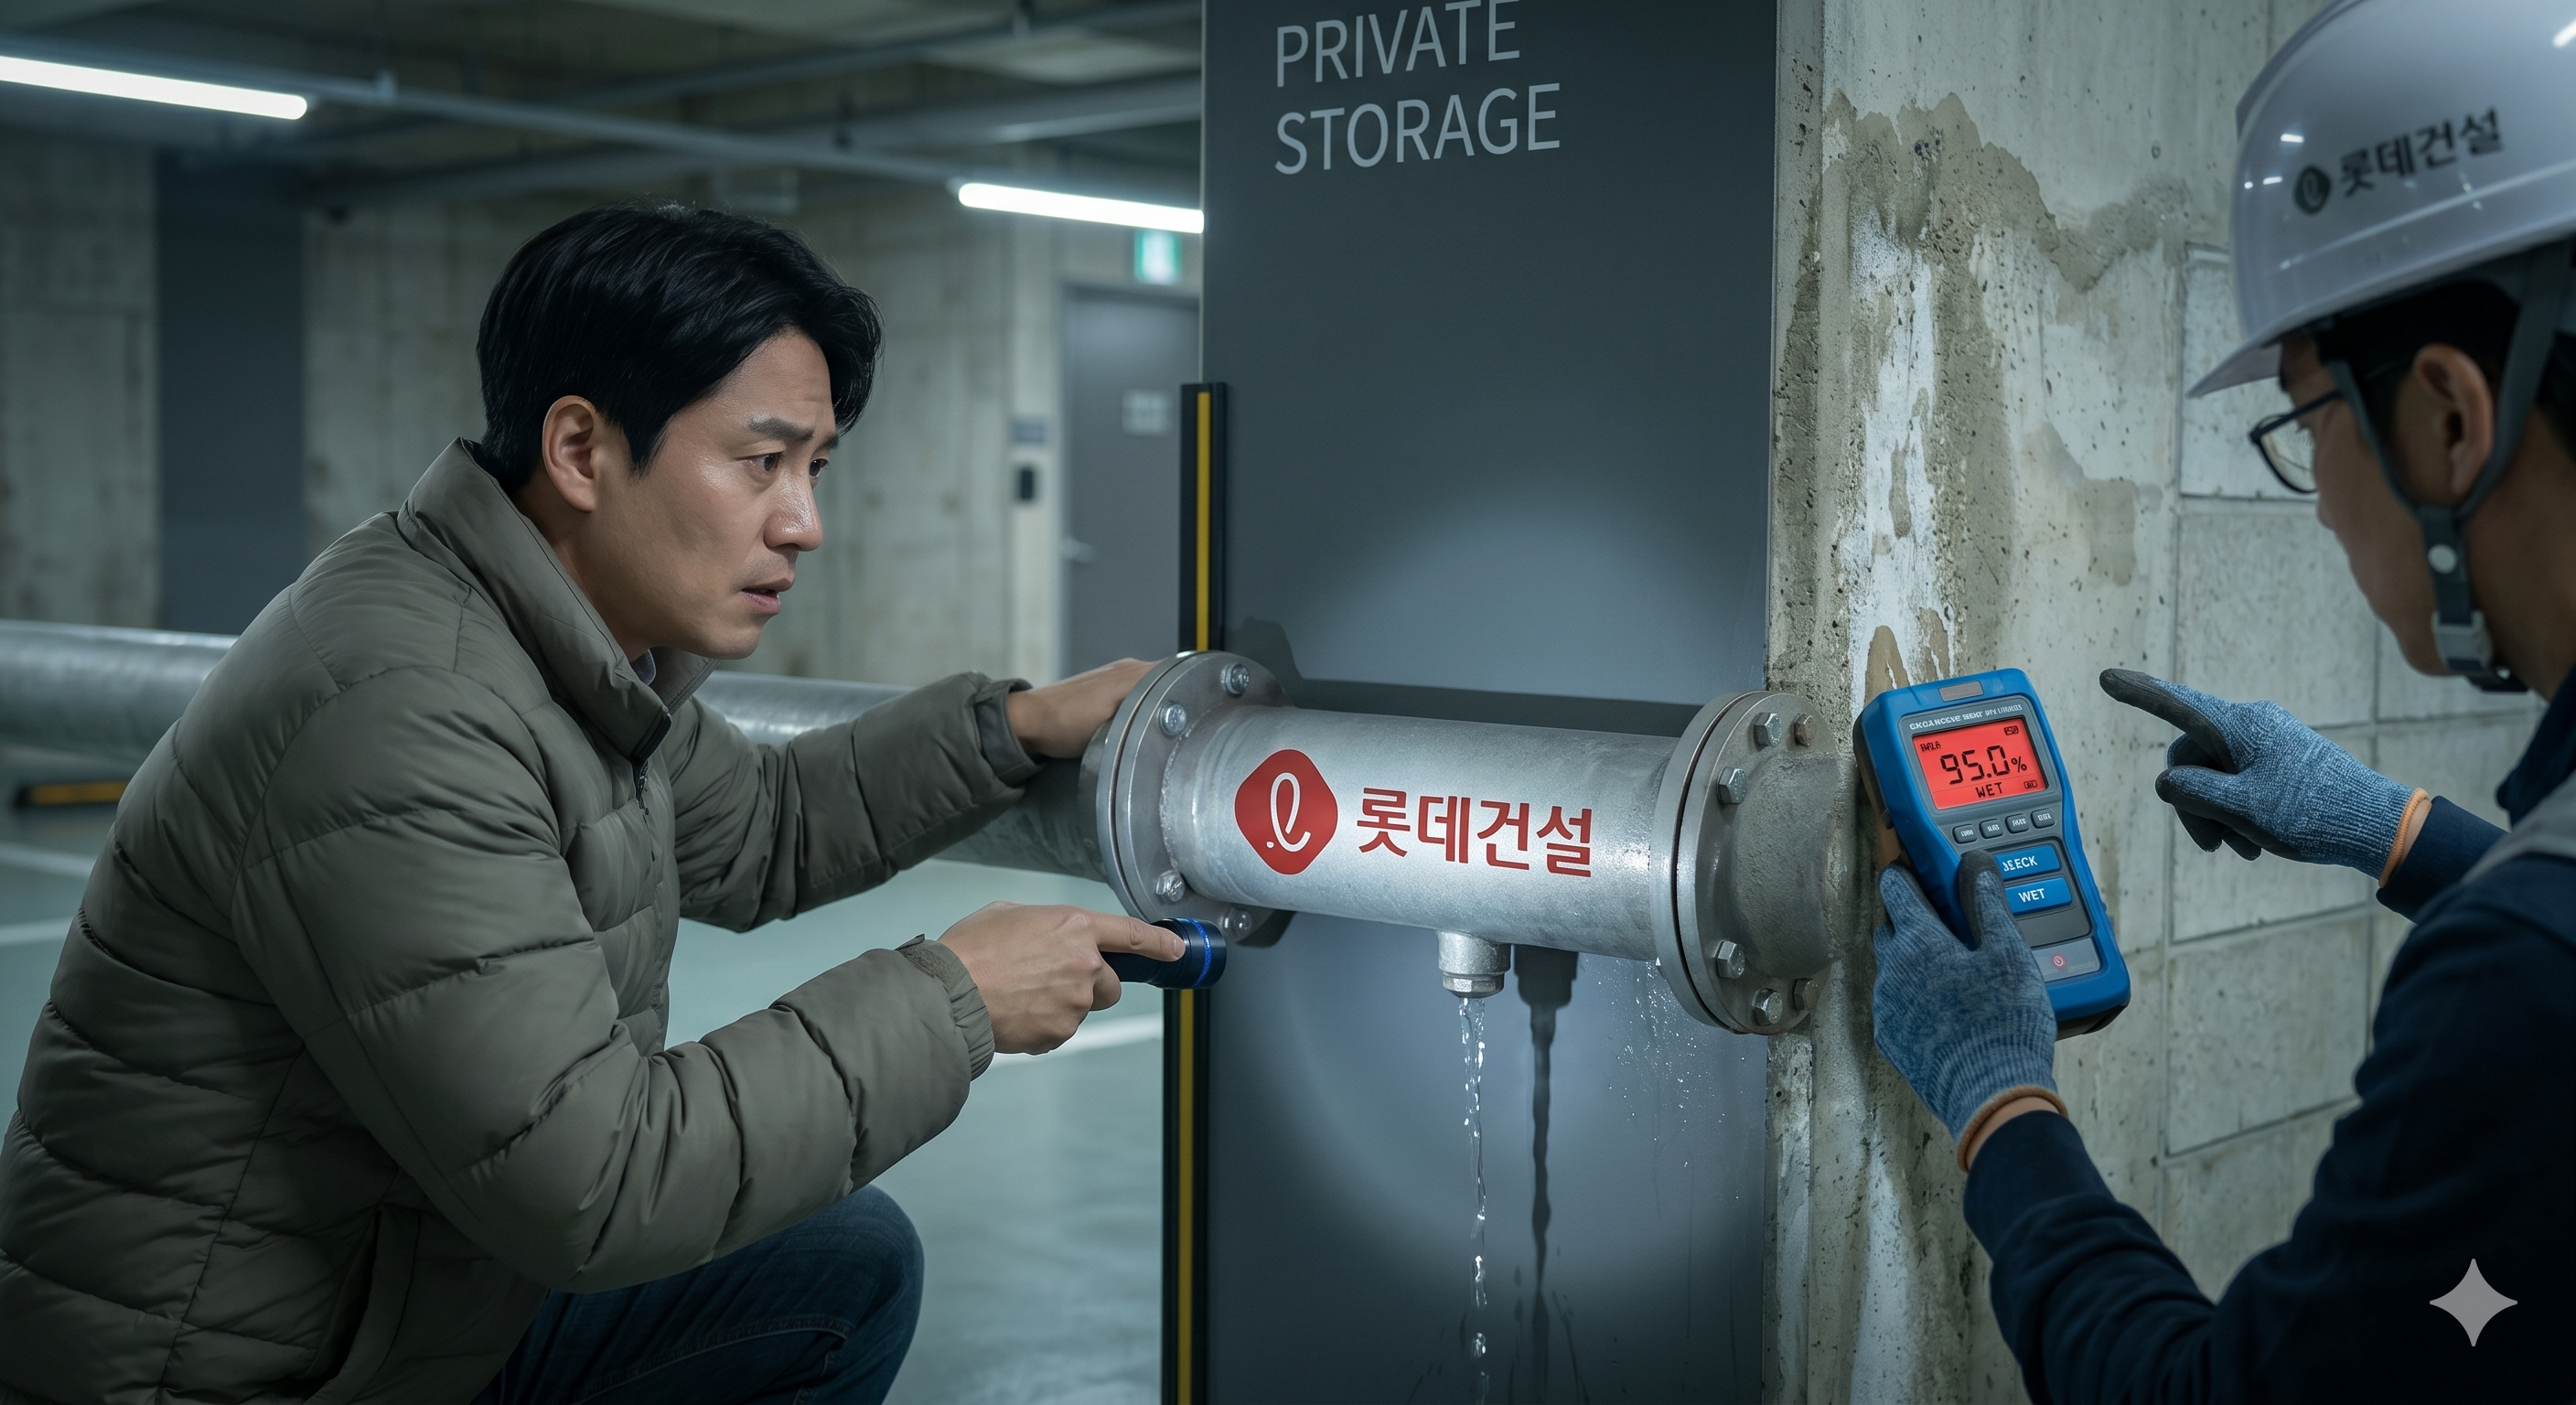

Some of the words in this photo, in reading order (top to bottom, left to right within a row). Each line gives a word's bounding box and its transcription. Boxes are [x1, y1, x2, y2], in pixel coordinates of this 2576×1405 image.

[1276, 0, 1520, 88] PRIVATE
[1274, 82, 1561, 175] STORAGE
[2339, 106, 2504, 198] 롯데건설
[1357, 788, 1593, 878] 롯데건설
[1975, 781, 2002, 799] WET
[2018, 887, 2045, 903] WET
